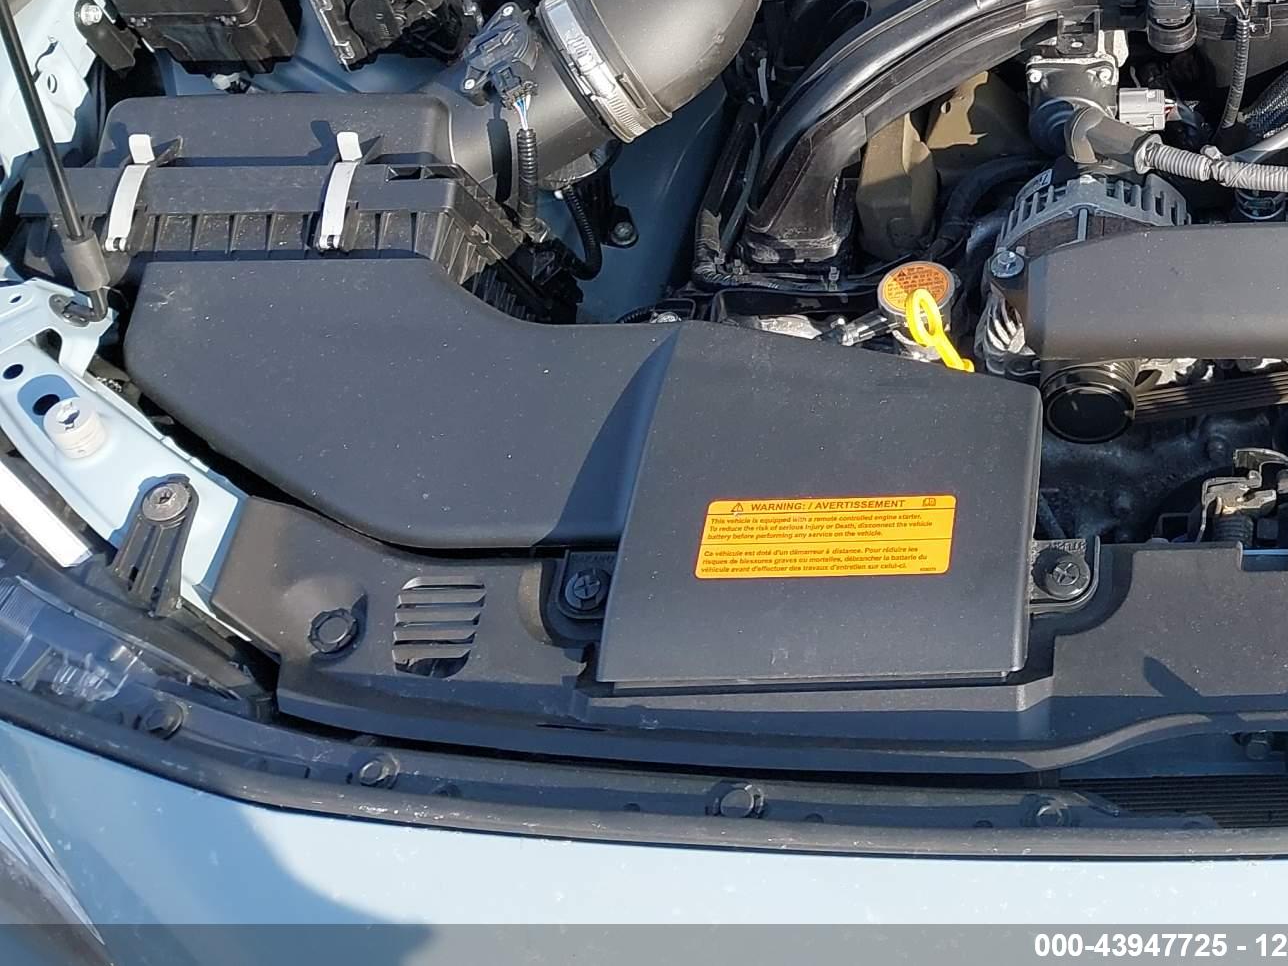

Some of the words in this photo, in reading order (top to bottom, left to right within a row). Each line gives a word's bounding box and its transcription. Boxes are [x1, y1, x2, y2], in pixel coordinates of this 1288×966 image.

[751, 502, 805, 512] WARNING:
[808, 502, 813, 510] /
[815, 499, 905, 510] AVERTISSEMENT
[760, 517, 791, 525] equipped
